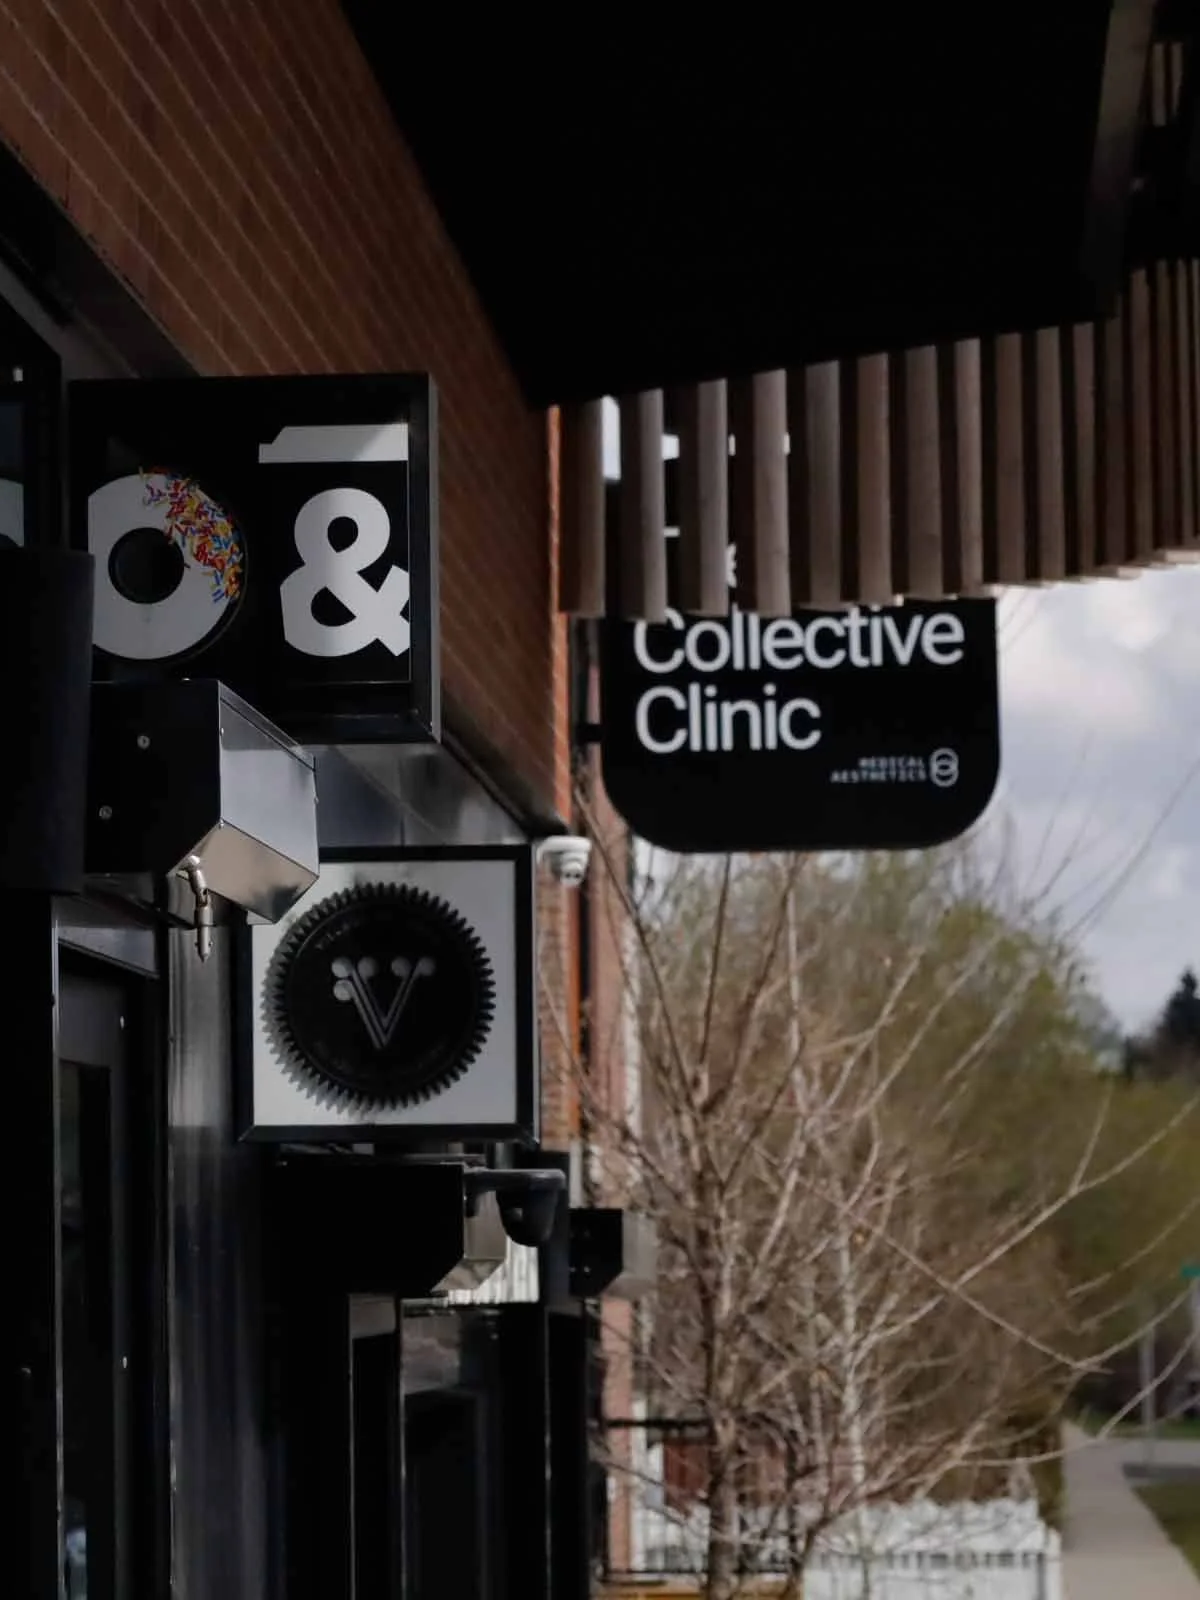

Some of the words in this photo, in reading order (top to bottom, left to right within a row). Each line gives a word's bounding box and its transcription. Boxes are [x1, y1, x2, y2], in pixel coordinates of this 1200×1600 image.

[280, 487, 409, 658] &
[633, 602, 964, 674] Collective
[635, 683, 821, 754] Clinic
